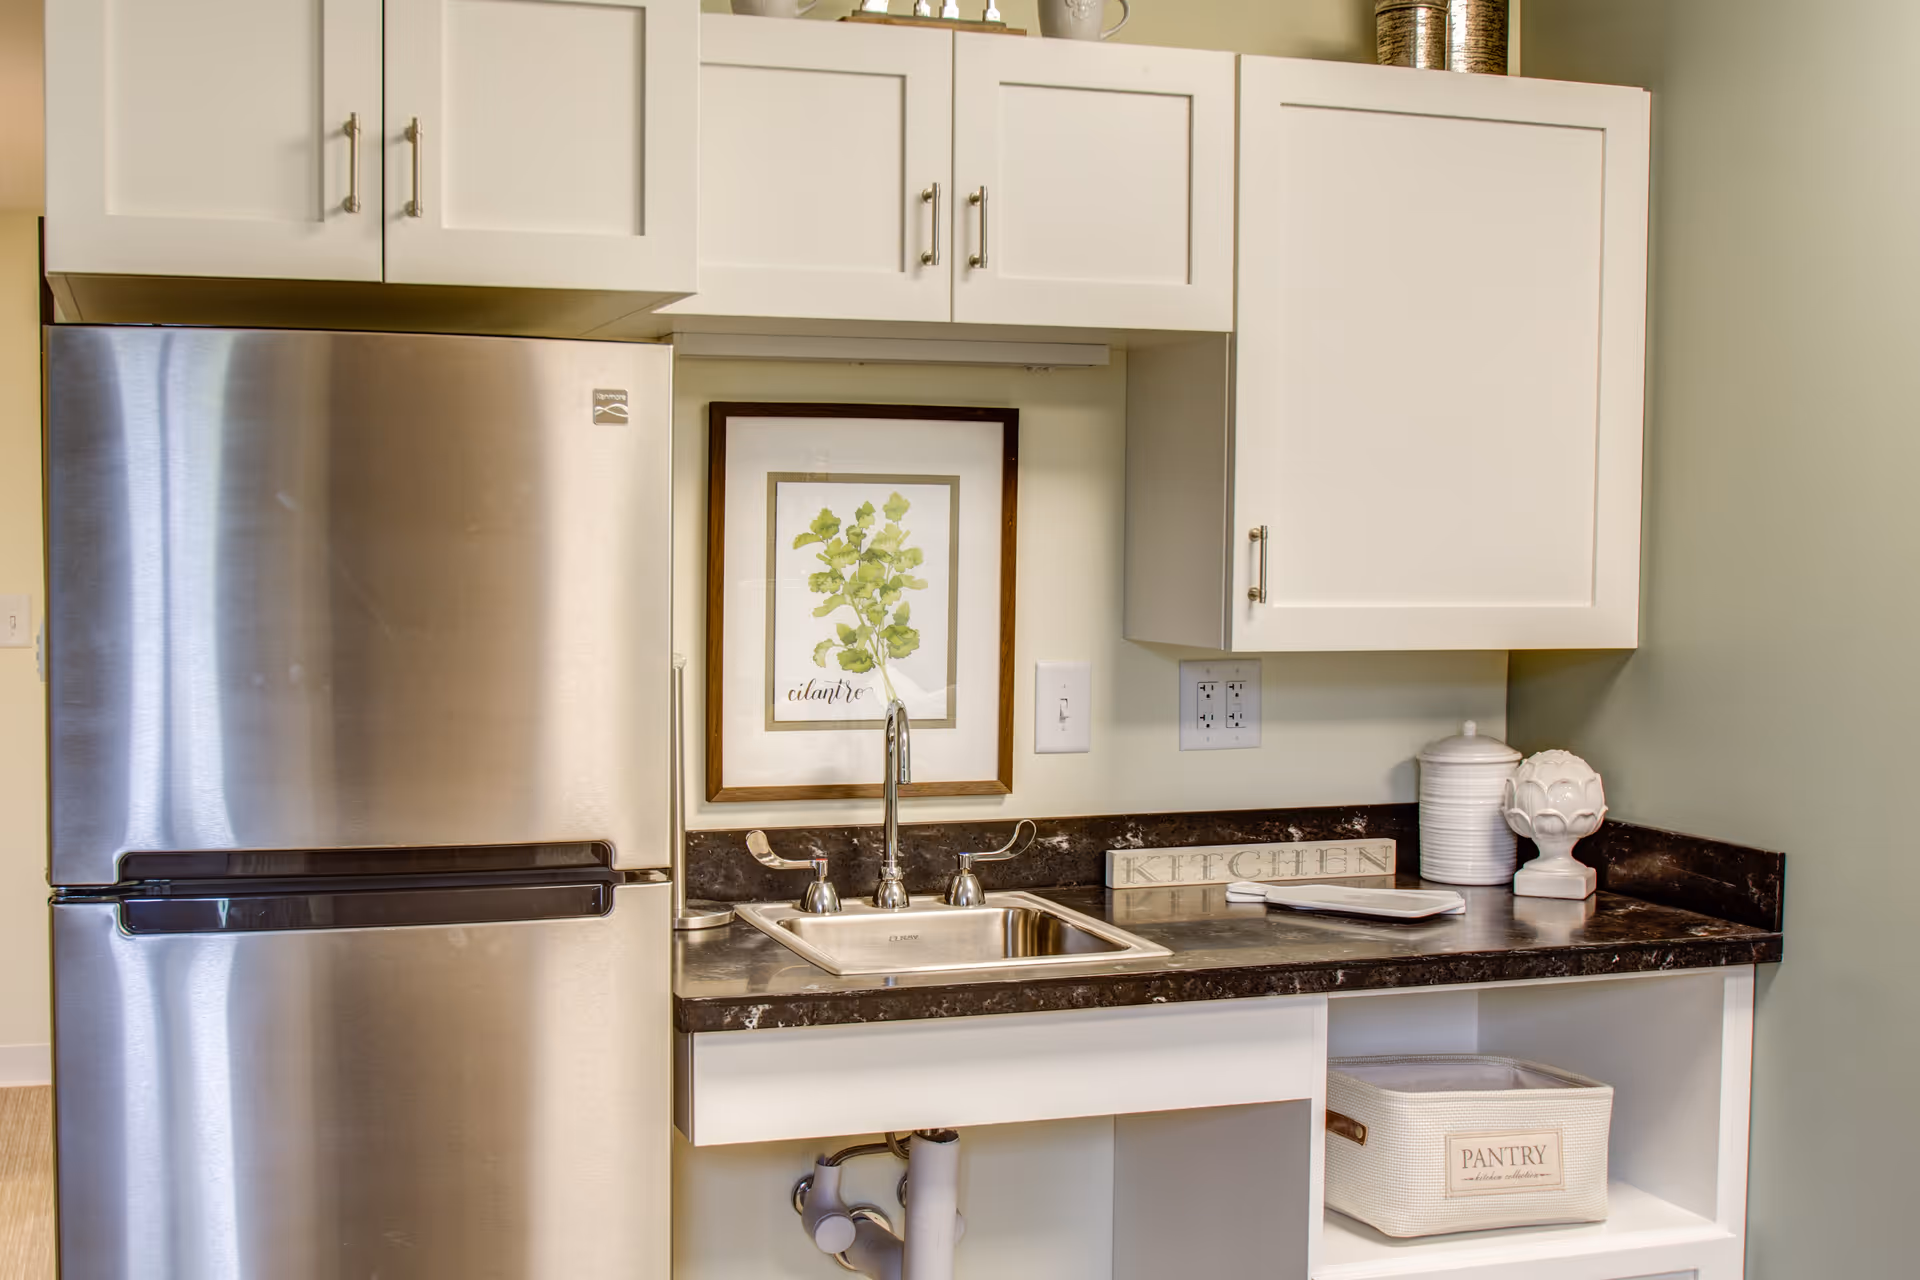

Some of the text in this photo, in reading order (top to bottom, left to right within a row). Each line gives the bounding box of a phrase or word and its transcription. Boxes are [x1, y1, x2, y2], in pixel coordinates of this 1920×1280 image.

[788, 678, 873, 704] cilantro
[1120, 845, 1392, 885] KITCHEN
[1461, 1145, 1547, 1169] PANTRY
